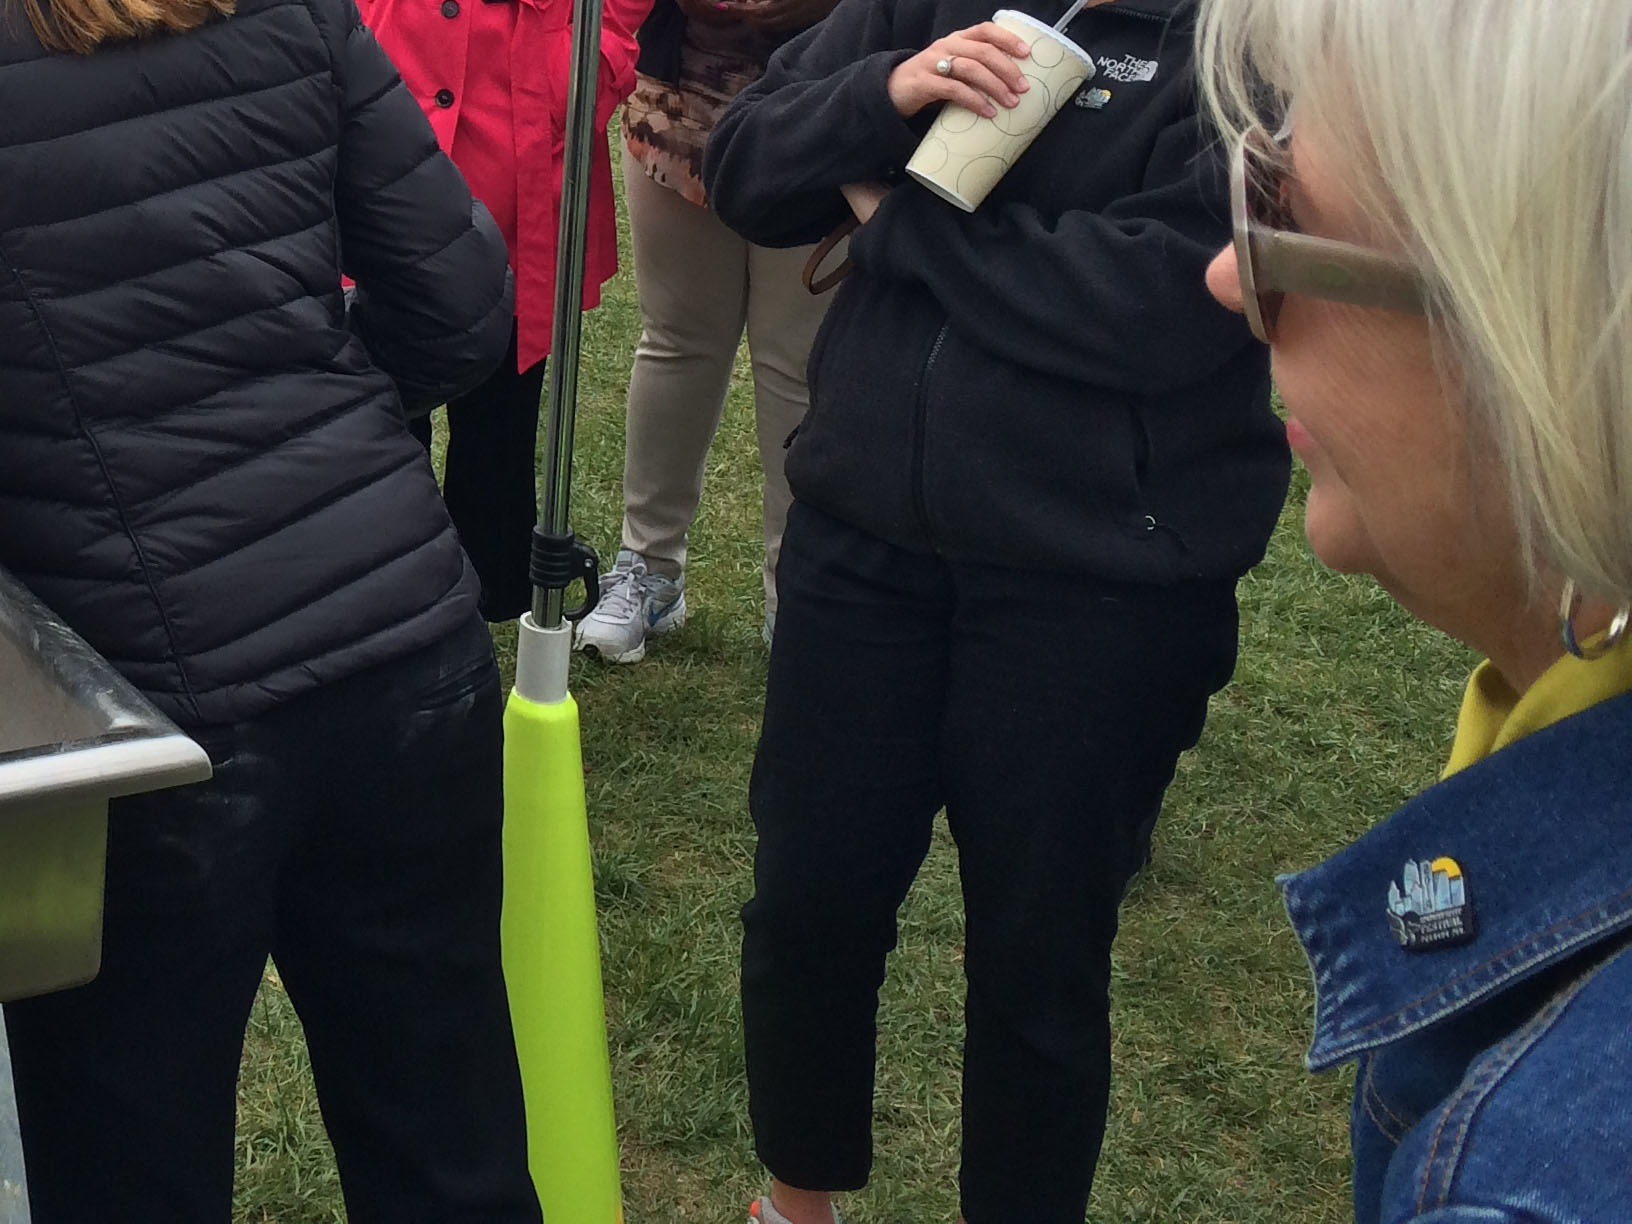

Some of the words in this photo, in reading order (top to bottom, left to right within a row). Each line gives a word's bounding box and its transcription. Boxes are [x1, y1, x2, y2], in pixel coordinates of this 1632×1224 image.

[1096, 55, 1143, 75] NORTH
[1124, 53, 1149, 68] THE
[1103, 68, 1136, 82] FACE
